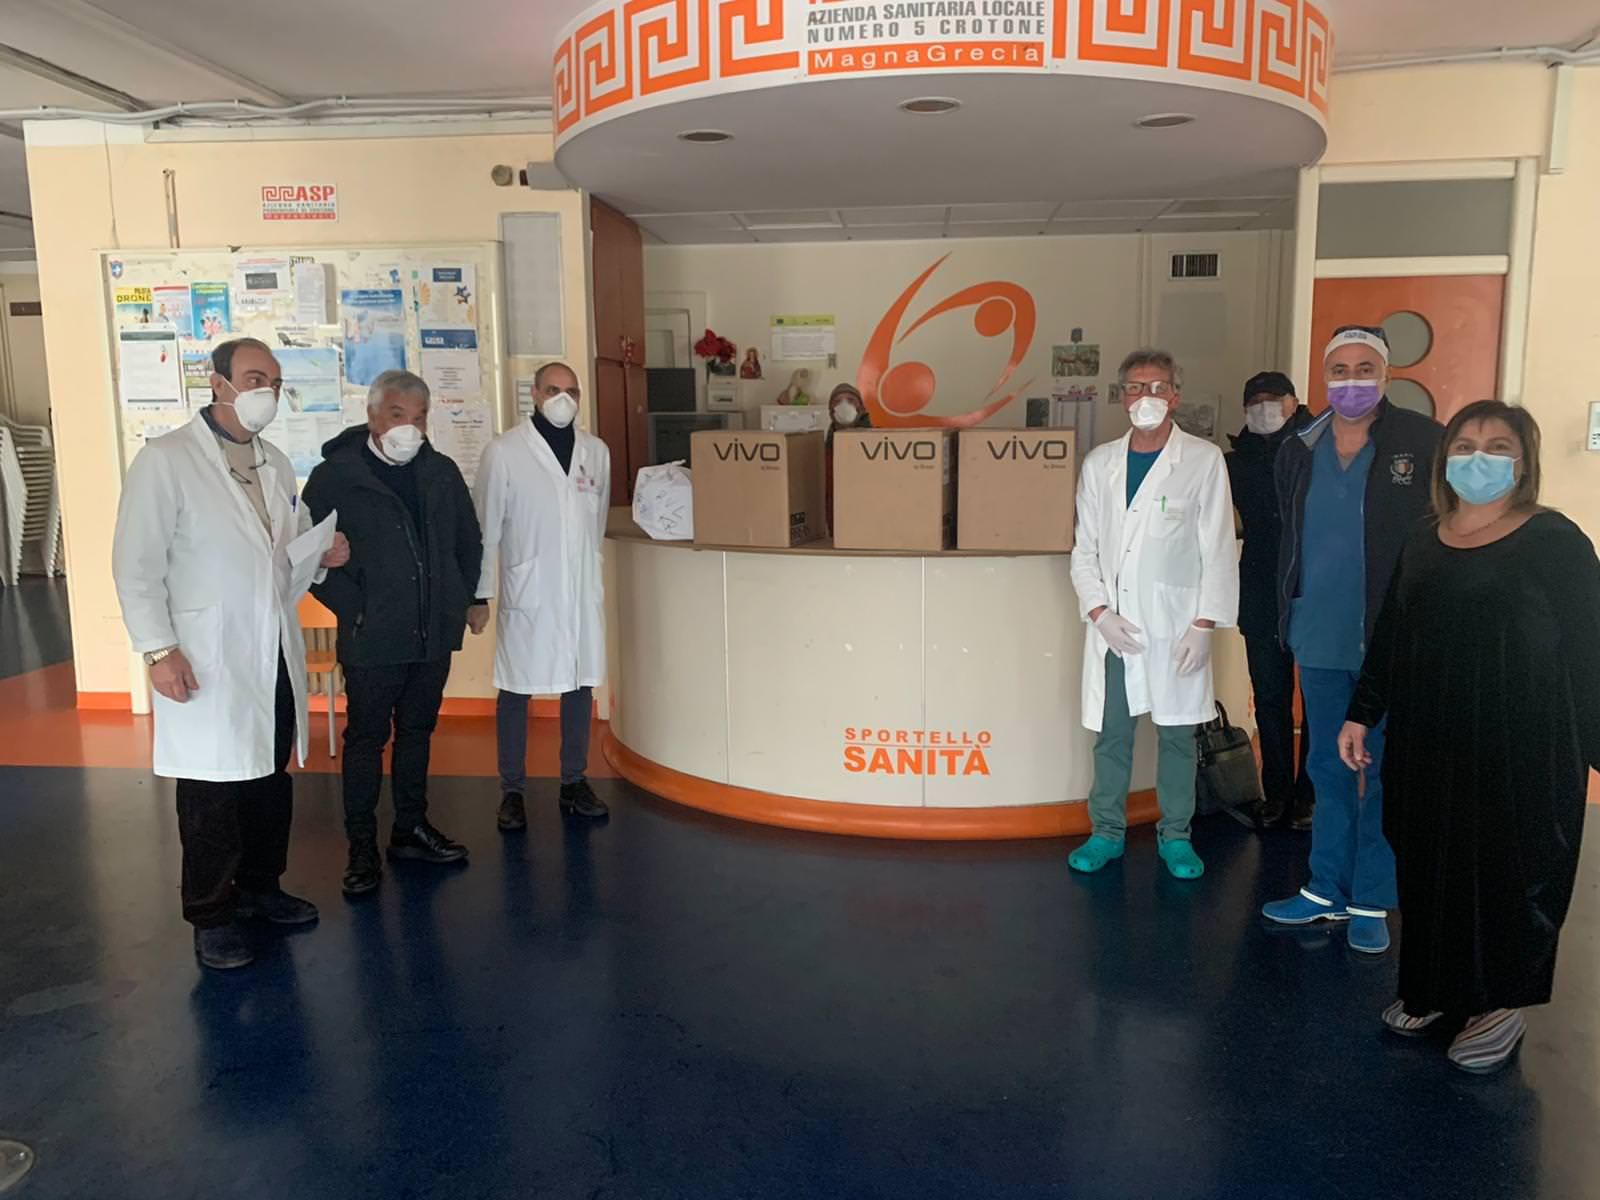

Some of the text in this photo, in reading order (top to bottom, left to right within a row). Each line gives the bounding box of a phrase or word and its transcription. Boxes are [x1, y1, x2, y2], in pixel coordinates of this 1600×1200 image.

[808, 1, 1044, 26] AZIENDA SANITARIA LOCALE
[808, 19, 1044, 44] NUMERO 5 CROTONE
[814, 44, 1039, 69] MagnaGrecia
[296, 185, 334, 201] ASP
[845, 728, 991, 744] SPORTELLO
[844, 744, 990, 775] SANITÀ
